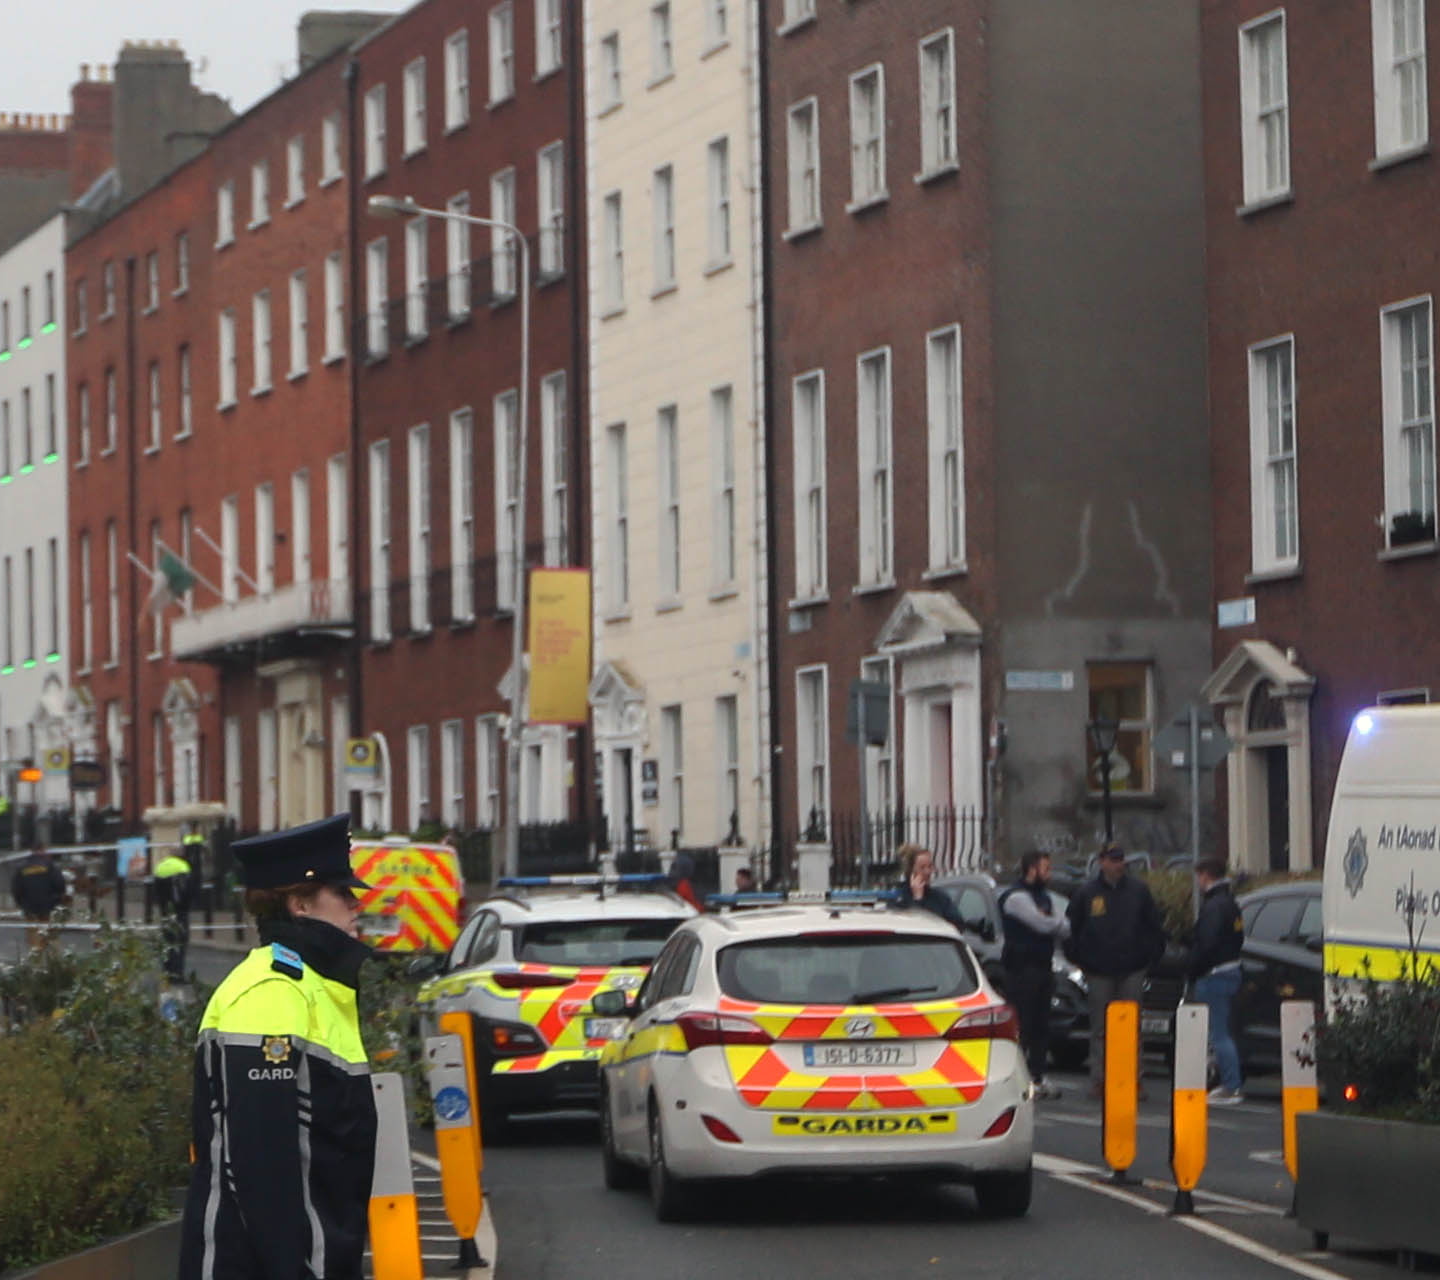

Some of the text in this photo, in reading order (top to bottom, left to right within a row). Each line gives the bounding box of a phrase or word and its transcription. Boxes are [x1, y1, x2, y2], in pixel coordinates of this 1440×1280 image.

[1377, 823, 1393, 849] An
[1396, 823, 1436, 850] tAonad
[247, 1068, 298, 1081] GARD
[801, 1117, 926, 1134] GARDA
